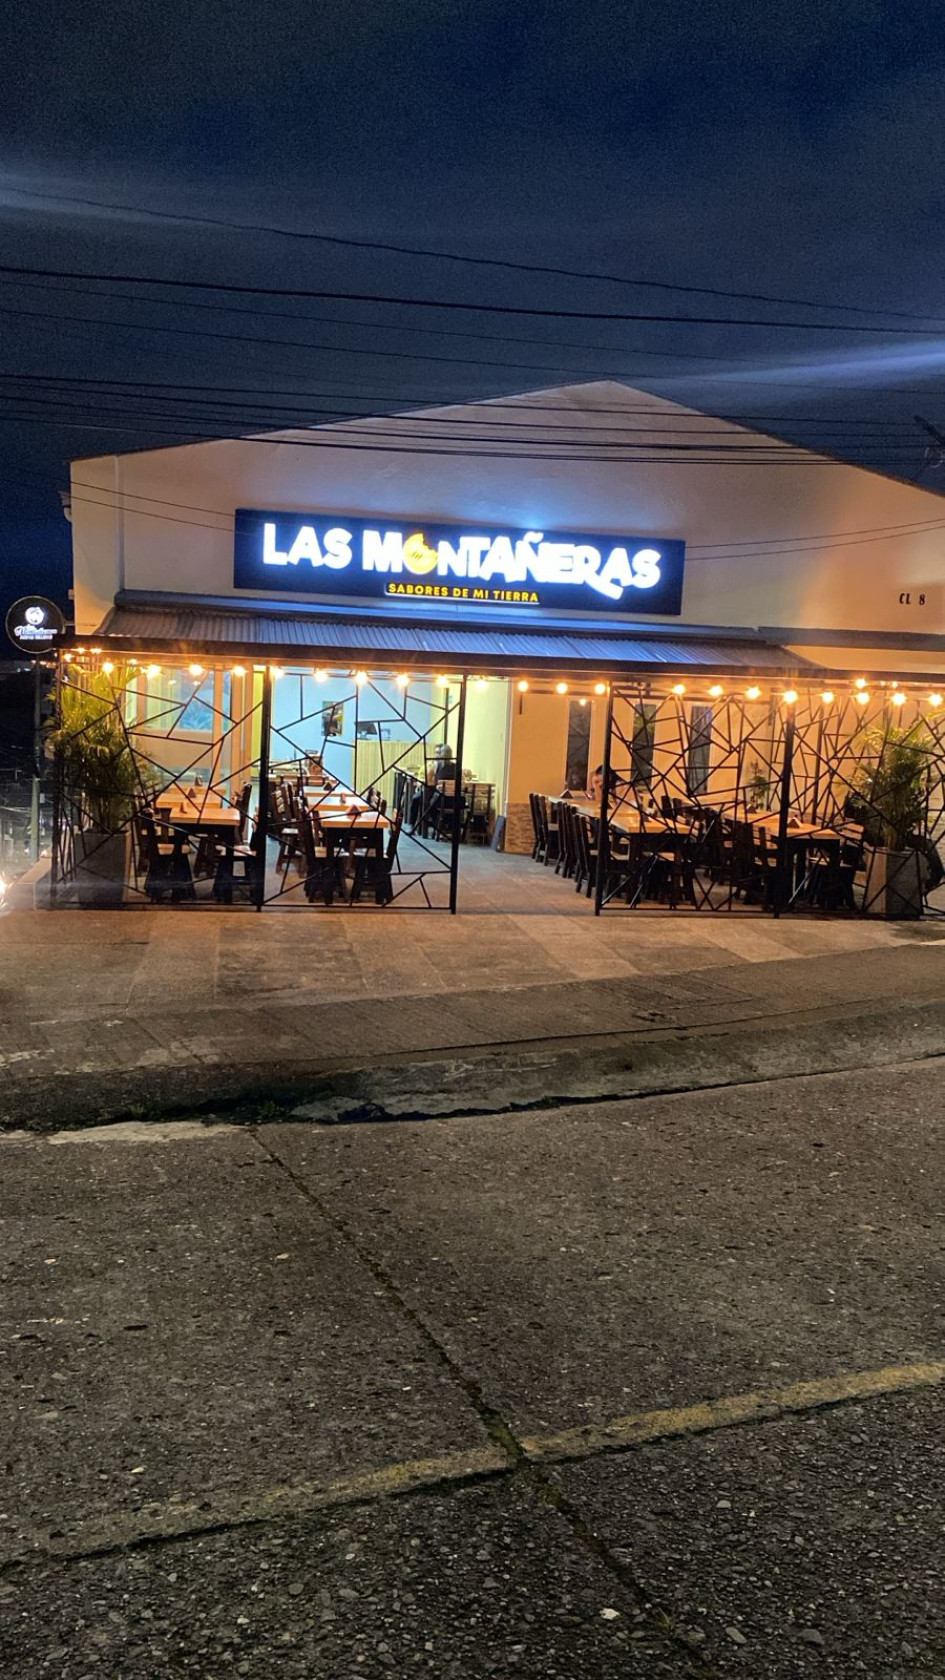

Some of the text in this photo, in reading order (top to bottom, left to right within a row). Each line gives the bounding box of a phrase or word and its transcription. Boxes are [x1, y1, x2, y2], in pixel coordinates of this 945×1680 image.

[262, 522, 661, 600] LAS MONTAÑERAS
[388, 583, 539, 603] SABORES DE MI TIERRA
[899, 592, 926, 606] CL 8
